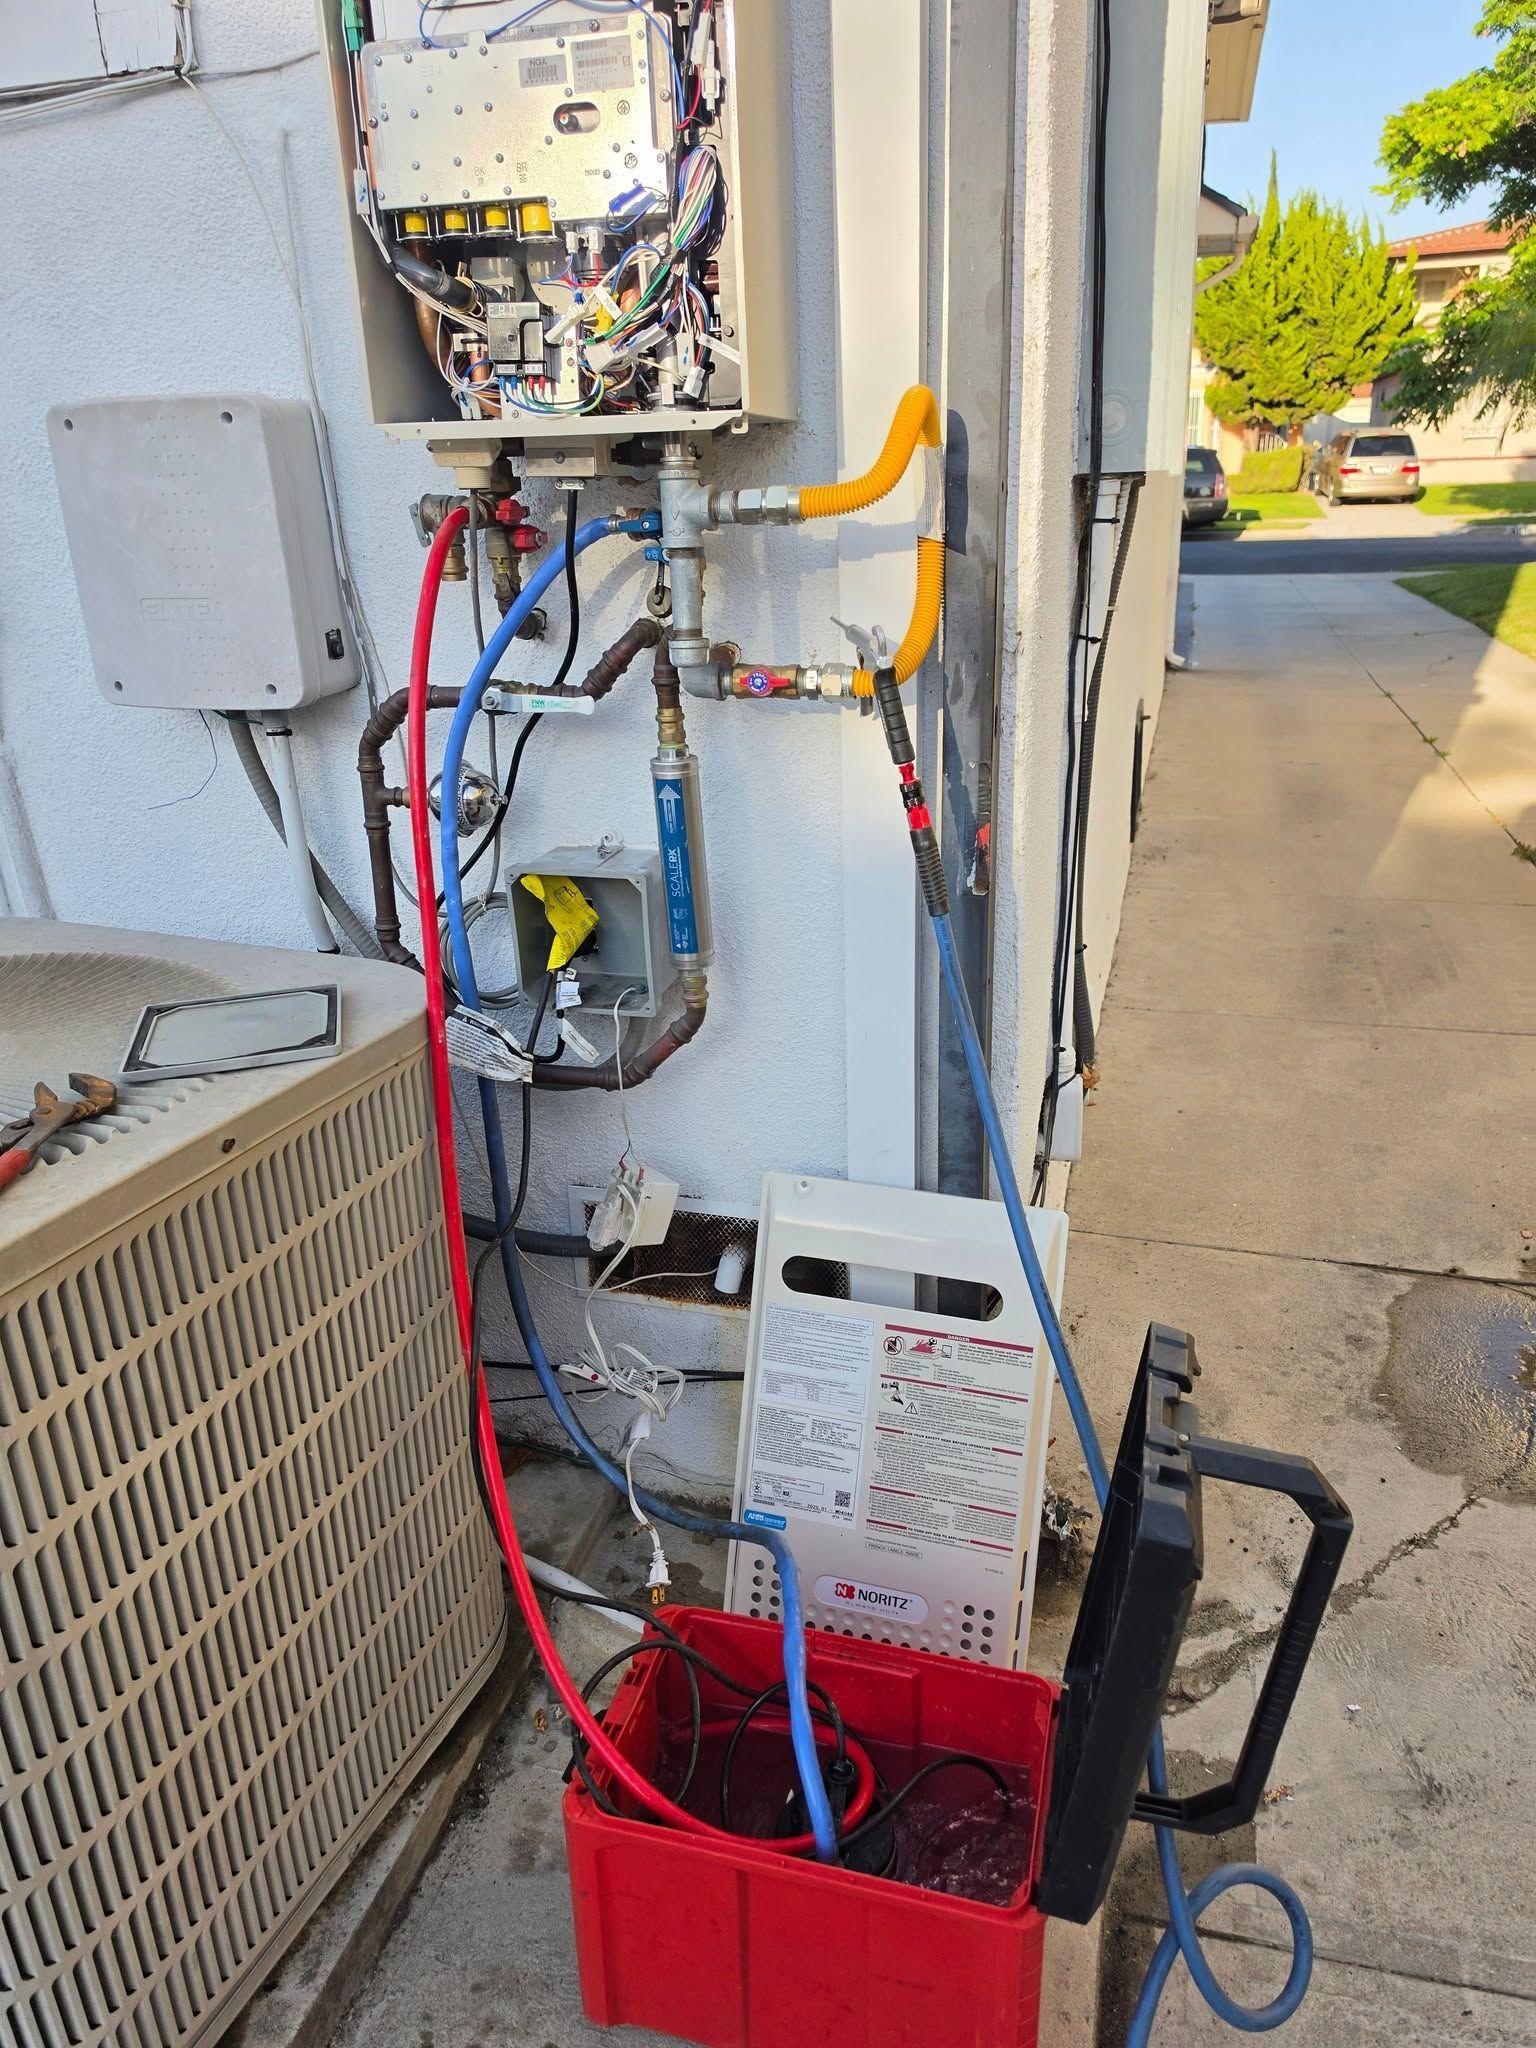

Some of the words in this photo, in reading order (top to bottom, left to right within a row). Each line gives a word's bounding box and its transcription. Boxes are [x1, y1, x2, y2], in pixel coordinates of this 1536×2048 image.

[529, 57, 547, 67] NGA
[667, 847, 681, 897] SCALERX
[946, 1334, 970, 1342] DANGER
[858, 1589, 909, 1610] NORITZ
